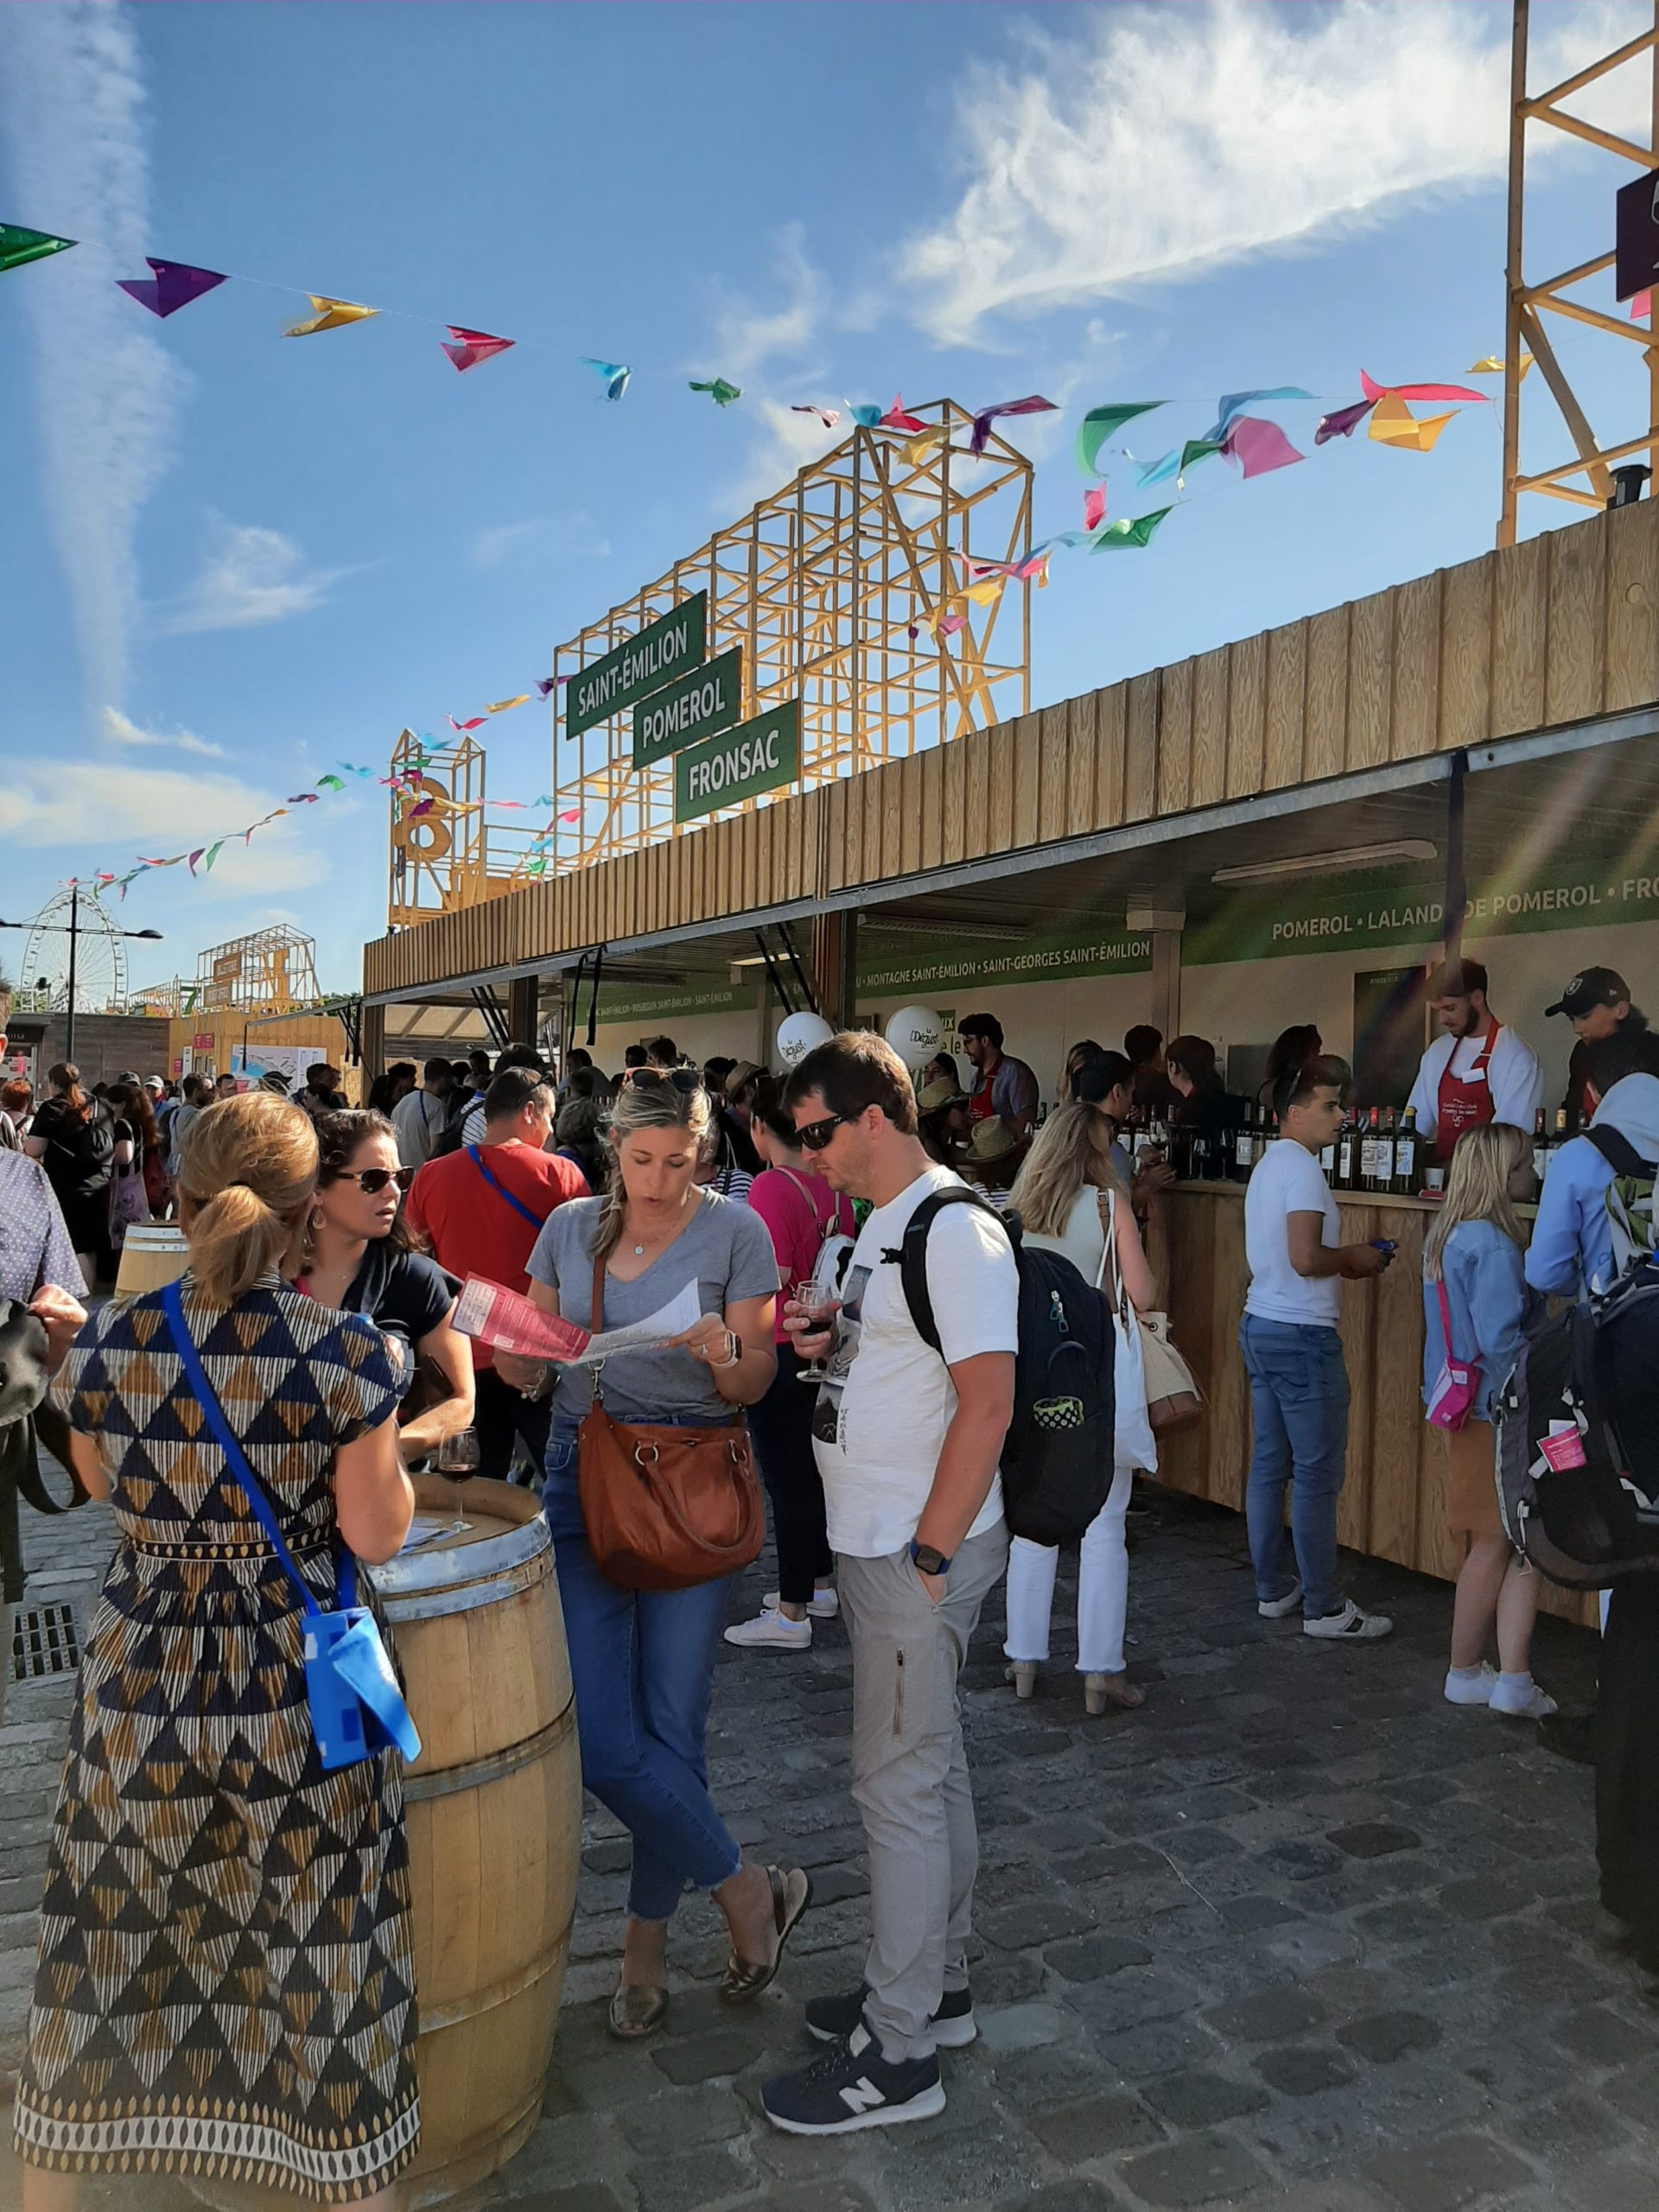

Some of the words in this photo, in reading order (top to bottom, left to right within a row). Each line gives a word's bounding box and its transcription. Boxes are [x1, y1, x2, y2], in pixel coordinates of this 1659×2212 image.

[578, 621, 687, 717] SAINT-ÉMILION
[643, 677, 726, 748] POMEROL
[689, 729, 779, 800] FRONSAC
[1272, 916, 1352, 940] POMEROL
[1368, 904, 1443, 928] LALAND
[1492, 883, 1601, 916] POMEROL
[867, 970, 911, 987] MONTAGNE
[912, 961, 976, 982] SAINT-ÉMILION
[982, 950, 1061, 974] SAINT-GEORGES
[1064, 940, 1150, 964] SAINT-ÉMILION
